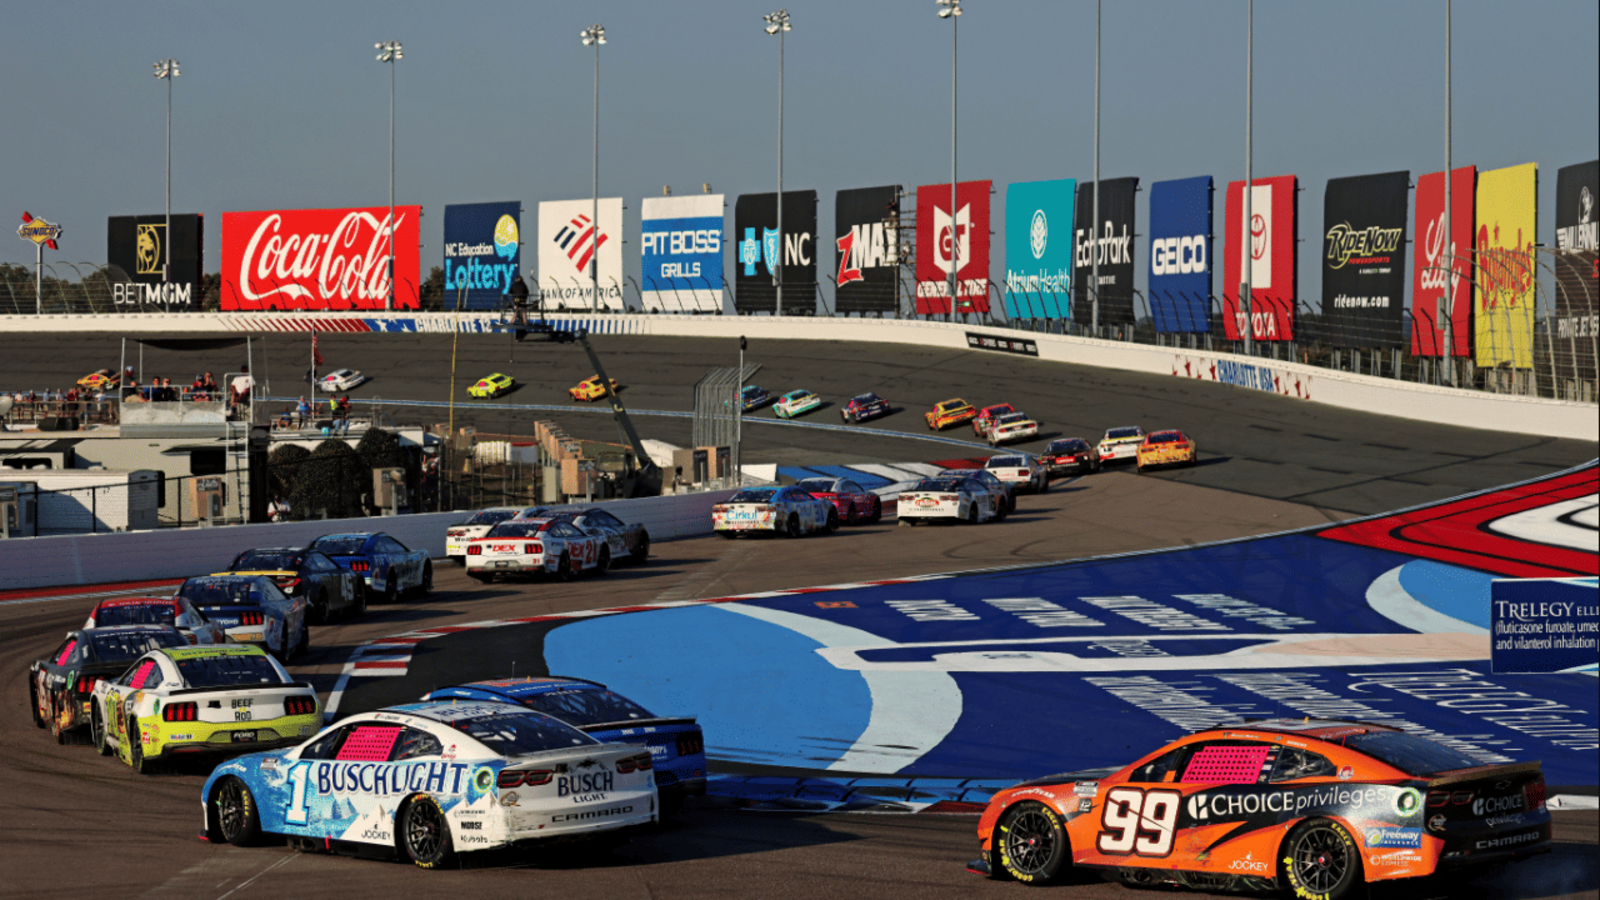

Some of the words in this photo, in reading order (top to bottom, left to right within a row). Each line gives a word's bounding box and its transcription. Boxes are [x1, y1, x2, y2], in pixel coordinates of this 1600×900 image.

[22, 227, 56, 236] SUNOCO
[445, 243, 458, 257] NC
[458, 243, 494, 256] Education
[641, 232, 670, 255] PIT
[670, 231, 721, 254] BOSS
[785, 233, 811, 266] NC
[240, 211, 406, 302] Coca-Cola
[1151, 235, 1207, 275] GEICO
[445, 257, 516, 295] Lottery
[661, 262, 701, 278] GRILLS
[917, 279, 963, 297] GENEL
[1005, 269, 1039, 294] Atrium
[1039, 268, 1071, 293] Health
[564, 287, 577, 299] OF
[578, 287, 622, 299] AMRICA
[1334, 293, 1390, 308] ridenow.com
[726, 509, 758, 520] Cirkul
[492, 544, 517, 553] DEX
[1495, 600, 1575, 623] TRELEGY
[1545, 619, 1576, 634] furoate,
[1495, 635, 1513, 650] and
[1514, 635, 1552, 650] vilanterol
[1553, 634, 1596, 649] inhalation
[231, 698, 254, 710] BEEF
[317, 763, 387, 796] BUSCH
[391, 761, 470, 797] LIGHT
[558, 771, 614, 797] BUSCH
[284, 761, 314, 827] 1
[573, 793, 606, 804] LIGHT
[1211, 791, 1295, 815] CHOICE
[1295, 786, 1389, 815] privileges
[1486, 793, 1522, 813] CHOICE
[551, 804, 633, 823] CAMARO
[1096, 786, 1182, 858] 99
[361, 828, 391, 840] JOCKEY
[1381, 828, 1420, 841] Freeway
[1476, 831, 1540, 850] CAMARO
[1228, 860, 1269, 872] JOCKEY
